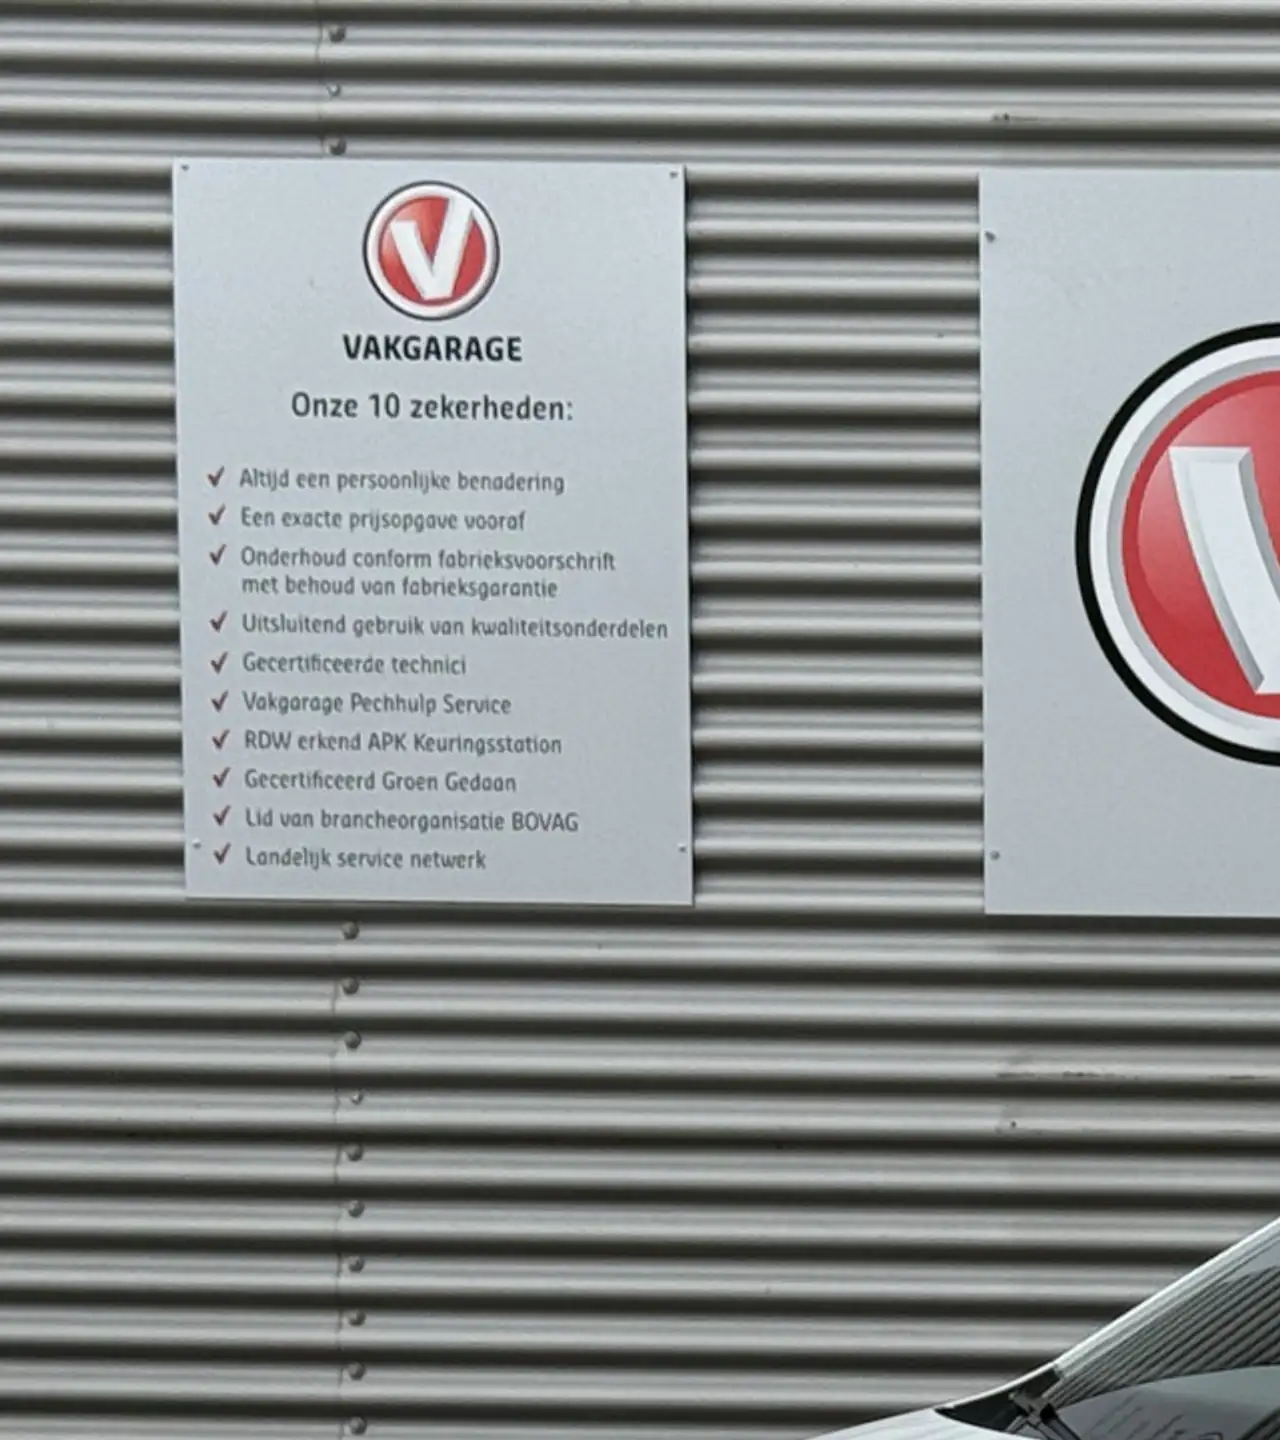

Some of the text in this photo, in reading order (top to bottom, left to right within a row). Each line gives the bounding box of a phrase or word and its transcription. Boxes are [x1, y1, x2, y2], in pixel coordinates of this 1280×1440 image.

[342, 334, 523, 362] VAKGARAGE
[291, 391, 573, 421] Onze 10 zekerheden:
[240, 468, 564, 496] Altijd een persoonlijke benadering
[241, 506, 525, 533] Een exacte prijsopgave vooraf
[241, 546, 615, 571] Onderhoud conform fabrieksvoorschrift
[242, 575, 557, 601] met behoud van fabrieksgarantie
[242, 613, 668, 639] Uitsluitend gebruik van kwaliteitsonderdelen
[243, 651, 466, 675] Gecertificeerde technici
[242, 691, 511, 717] Vakgarage Pechhulp Service
[244, 730, 561, 757] RDW erkend APK Keuringsstation
[244, 768, 516, 792] Gecertificeerd Groen Gedaan
[246, 808, 578, 834] Lid van brancheorganisatie BOVAG
[246, 846, 486, 870] Landelijk service netwerk
